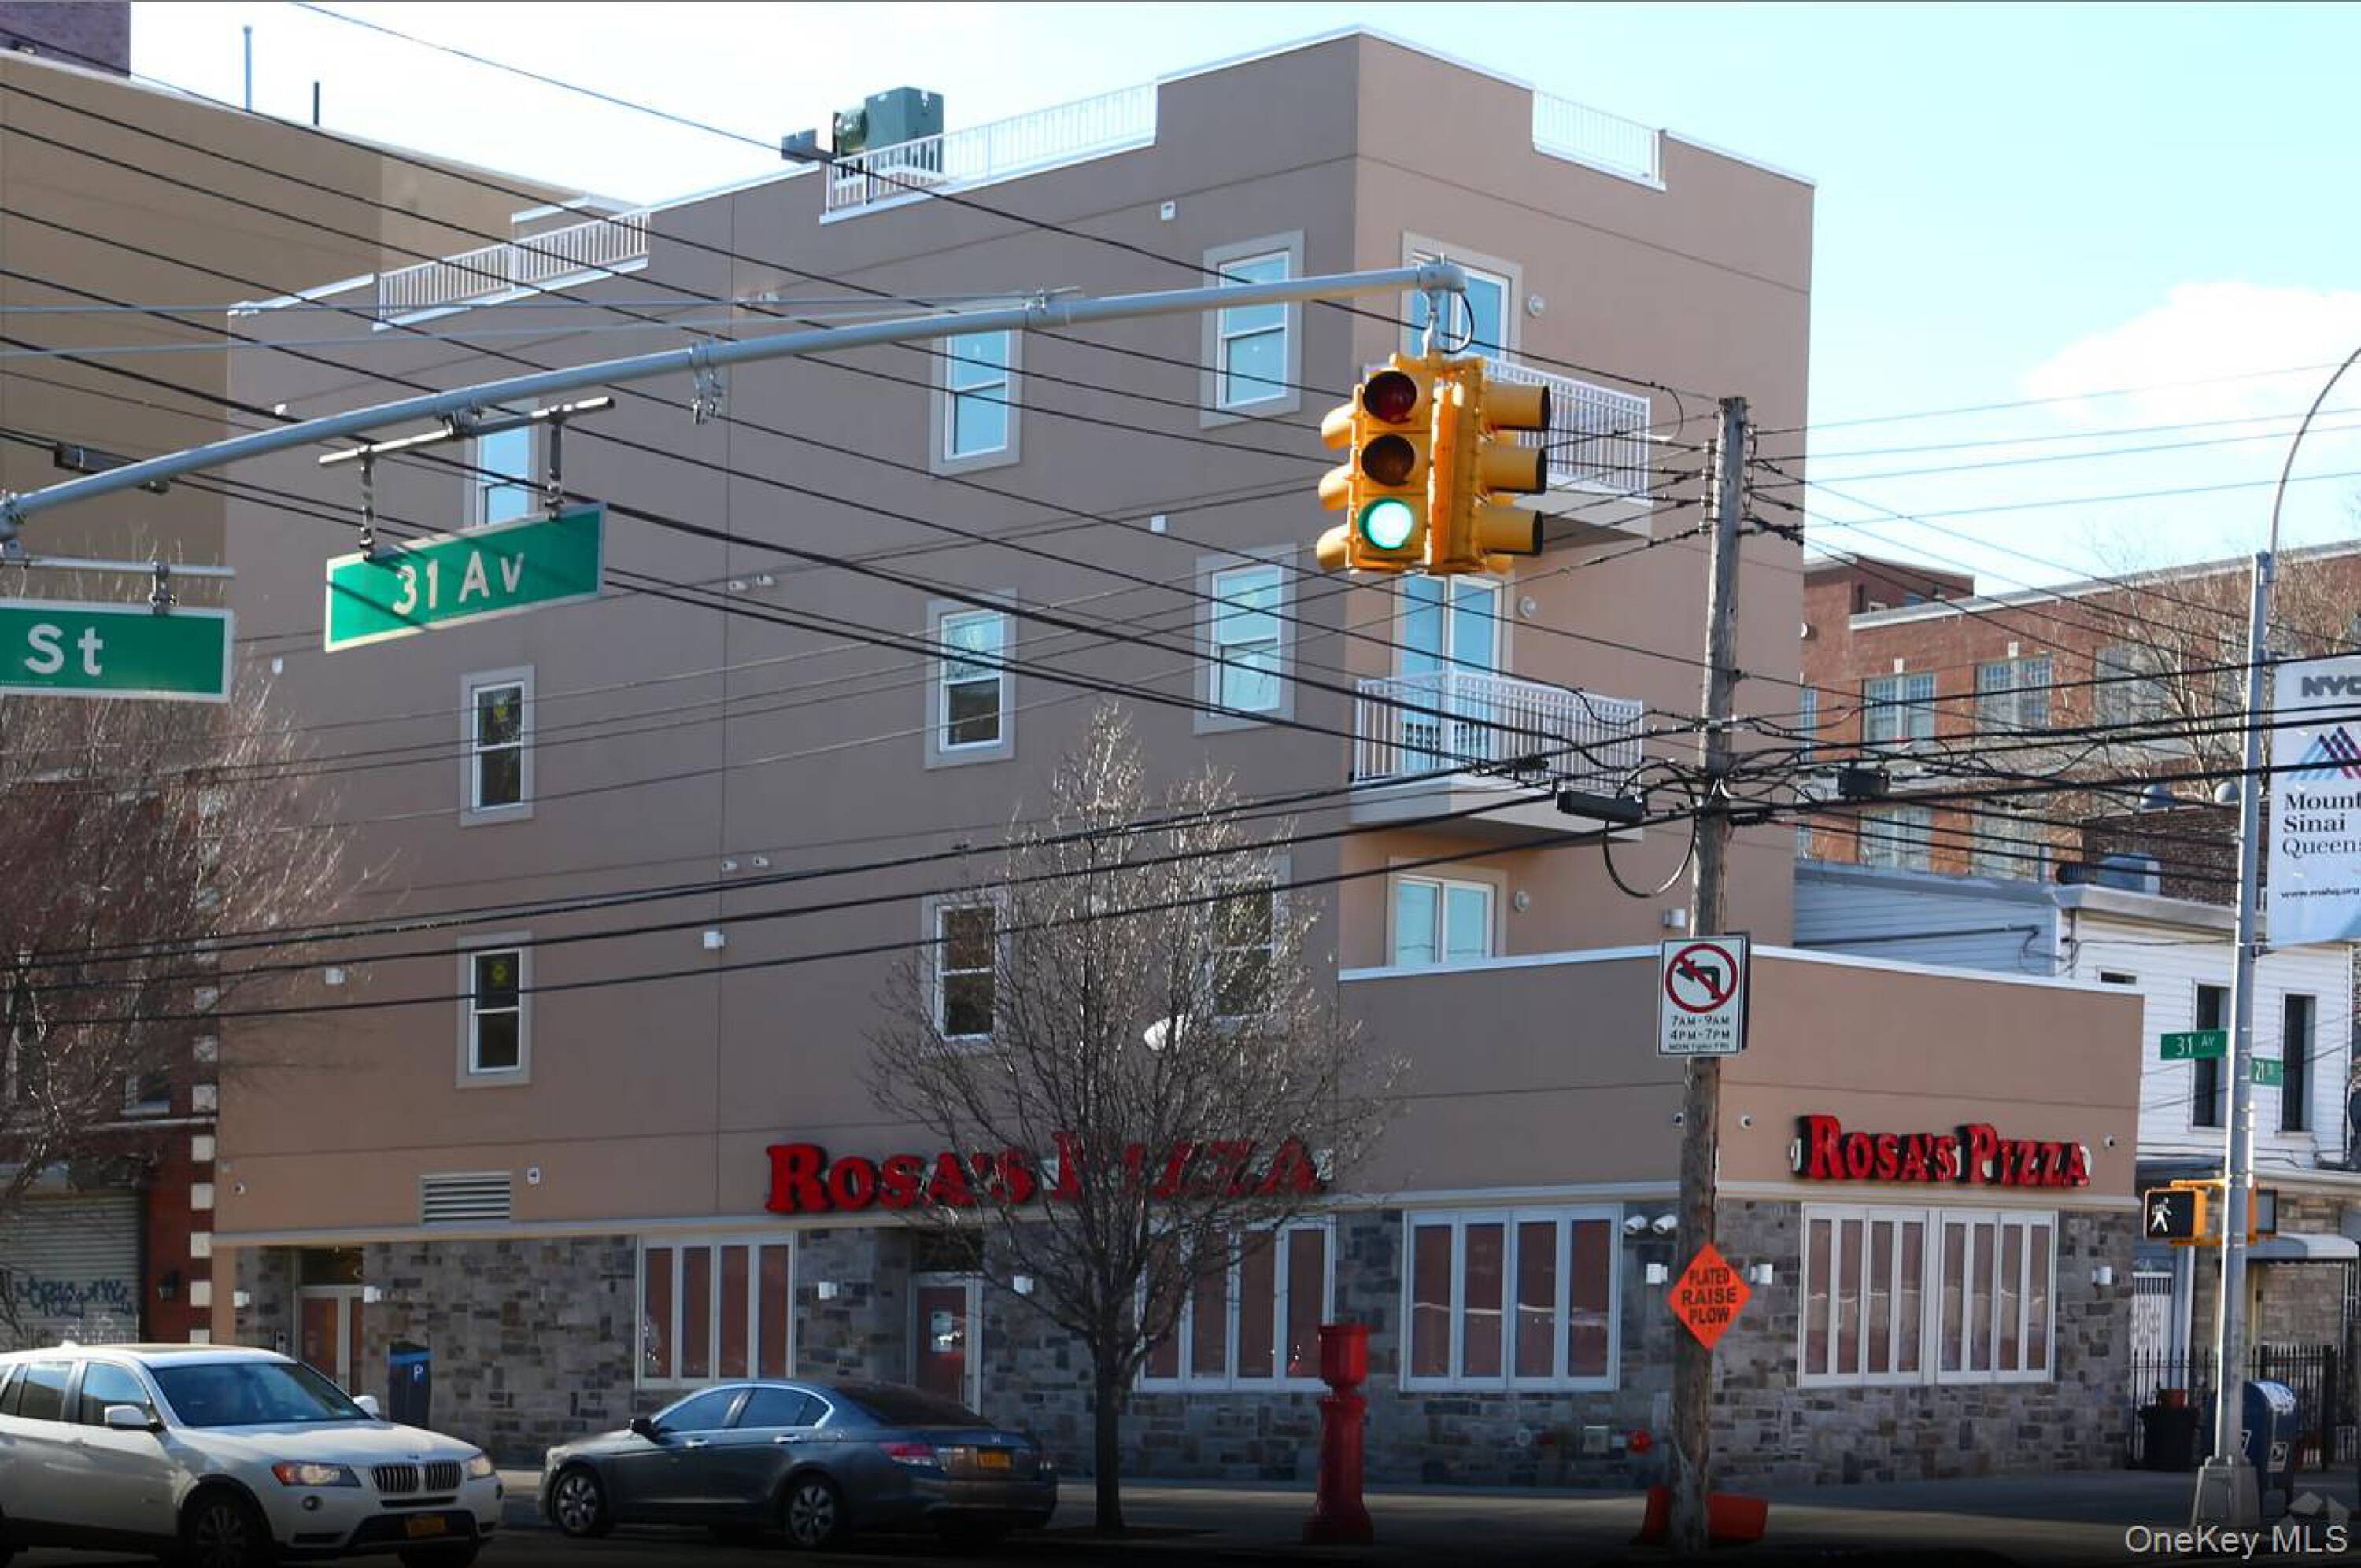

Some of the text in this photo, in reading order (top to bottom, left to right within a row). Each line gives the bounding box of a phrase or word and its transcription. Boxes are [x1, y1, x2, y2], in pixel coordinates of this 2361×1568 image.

[393, 559, 438, 614] 31
[25, 623, 103, 676] St
[2302, 675, 2361, 697] NYC
[2283, 813, 2345, 832] Sinai
[2175, 1035, 2193, 1057] 31
[1963, 1123, 2091, 1187] PIZZA
[1681, 1286, 1738, 1307] RAISE
[1688, 1307, 1730, 1324] PLOW
[413, 1363, 423, 1382] P
